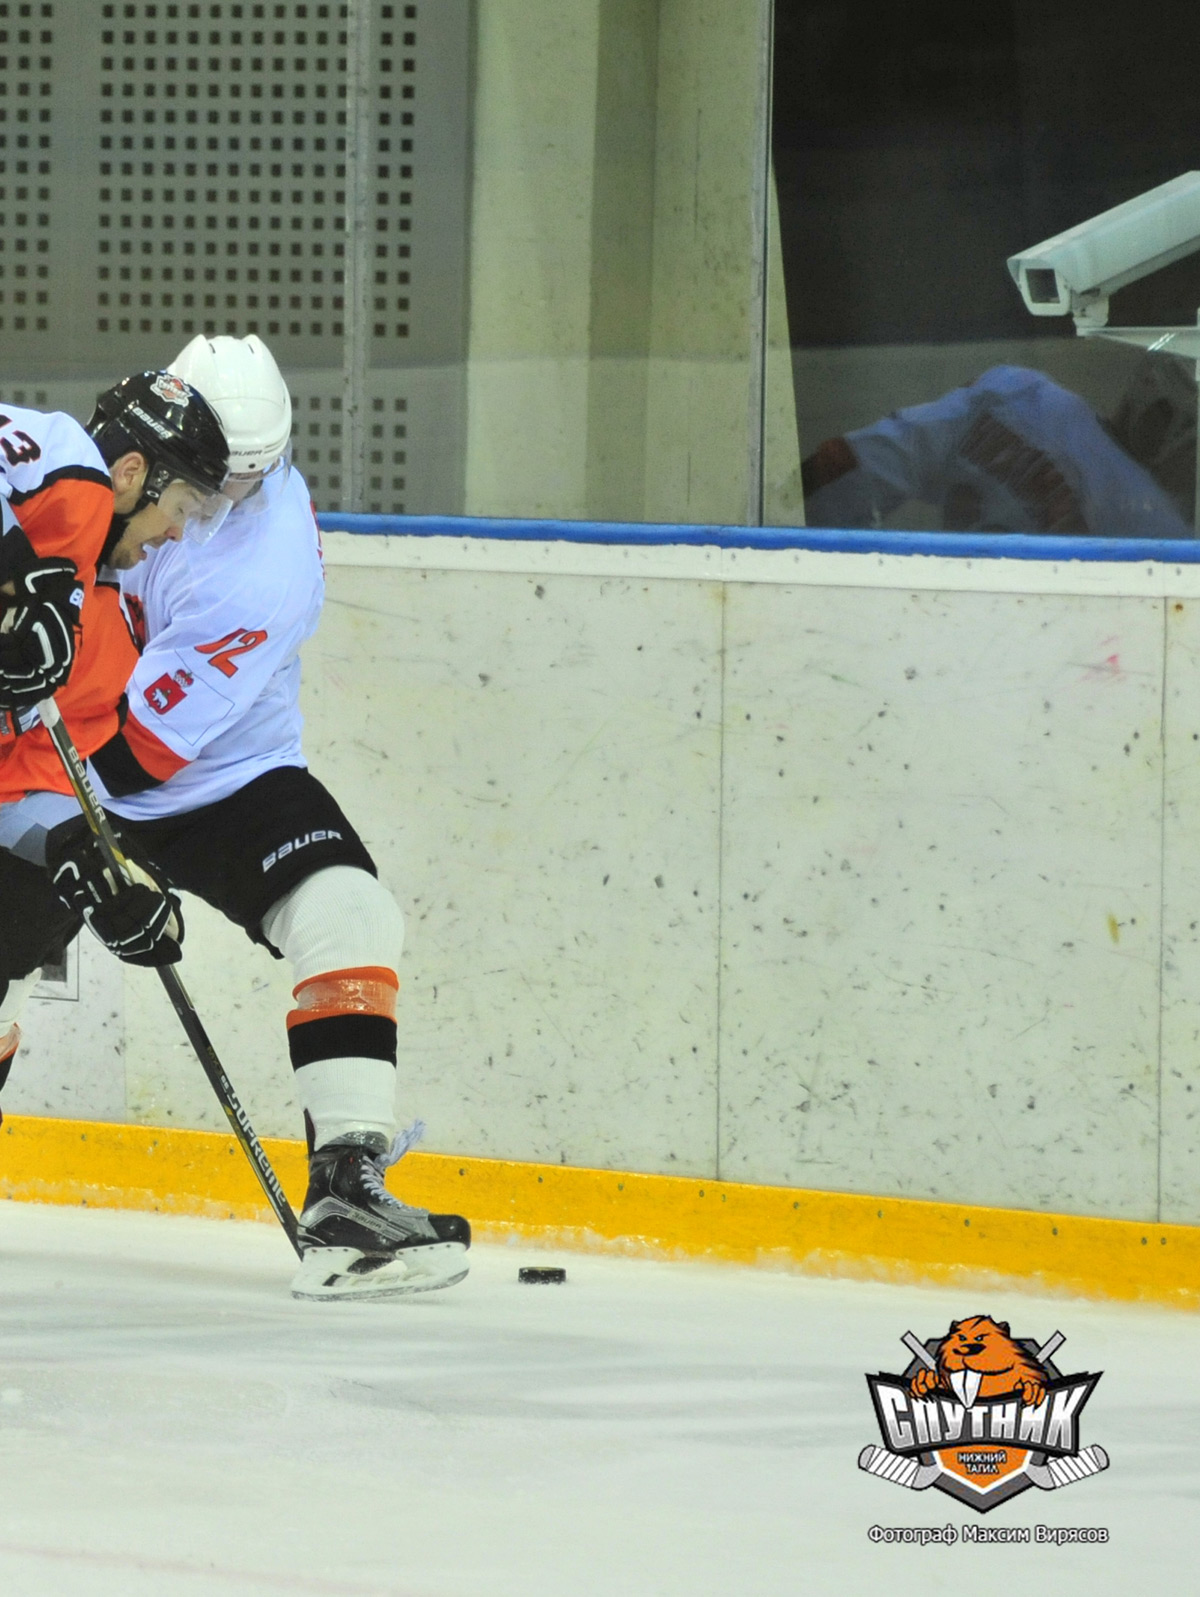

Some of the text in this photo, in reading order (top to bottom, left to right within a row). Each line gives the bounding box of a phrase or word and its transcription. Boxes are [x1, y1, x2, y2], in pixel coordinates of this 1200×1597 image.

[194, 620, 268, 679] 12
[68, 745, 107, 823] BAUER
[262, 829, 343, 873] BAUER
[226, 1091, 287, 1207] SUPREME
